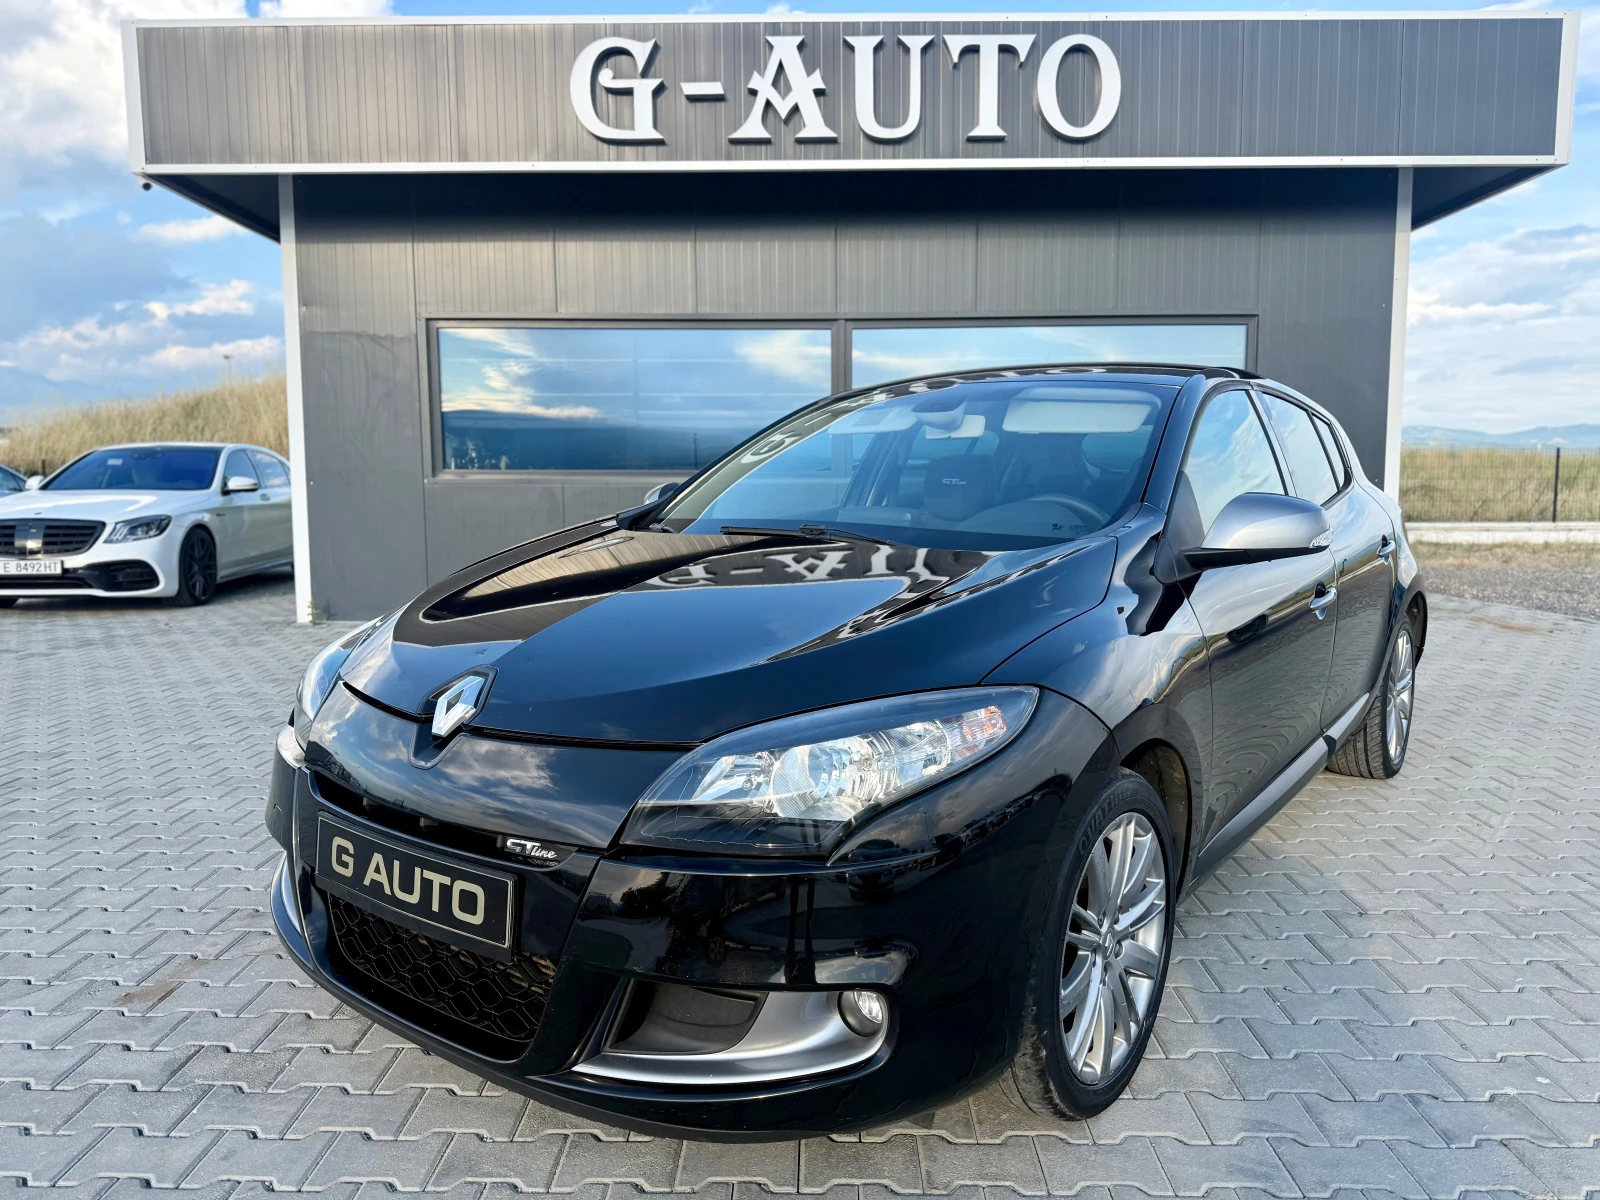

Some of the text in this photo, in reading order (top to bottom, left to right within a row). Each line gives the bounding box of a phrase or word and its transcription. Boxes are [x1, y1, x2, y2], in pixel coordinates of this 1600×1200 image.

[569, 33, 1122, 145] G-AUTO
[3, 562, 10, 573] E
[331, 836, 485, 925] G AUTO
